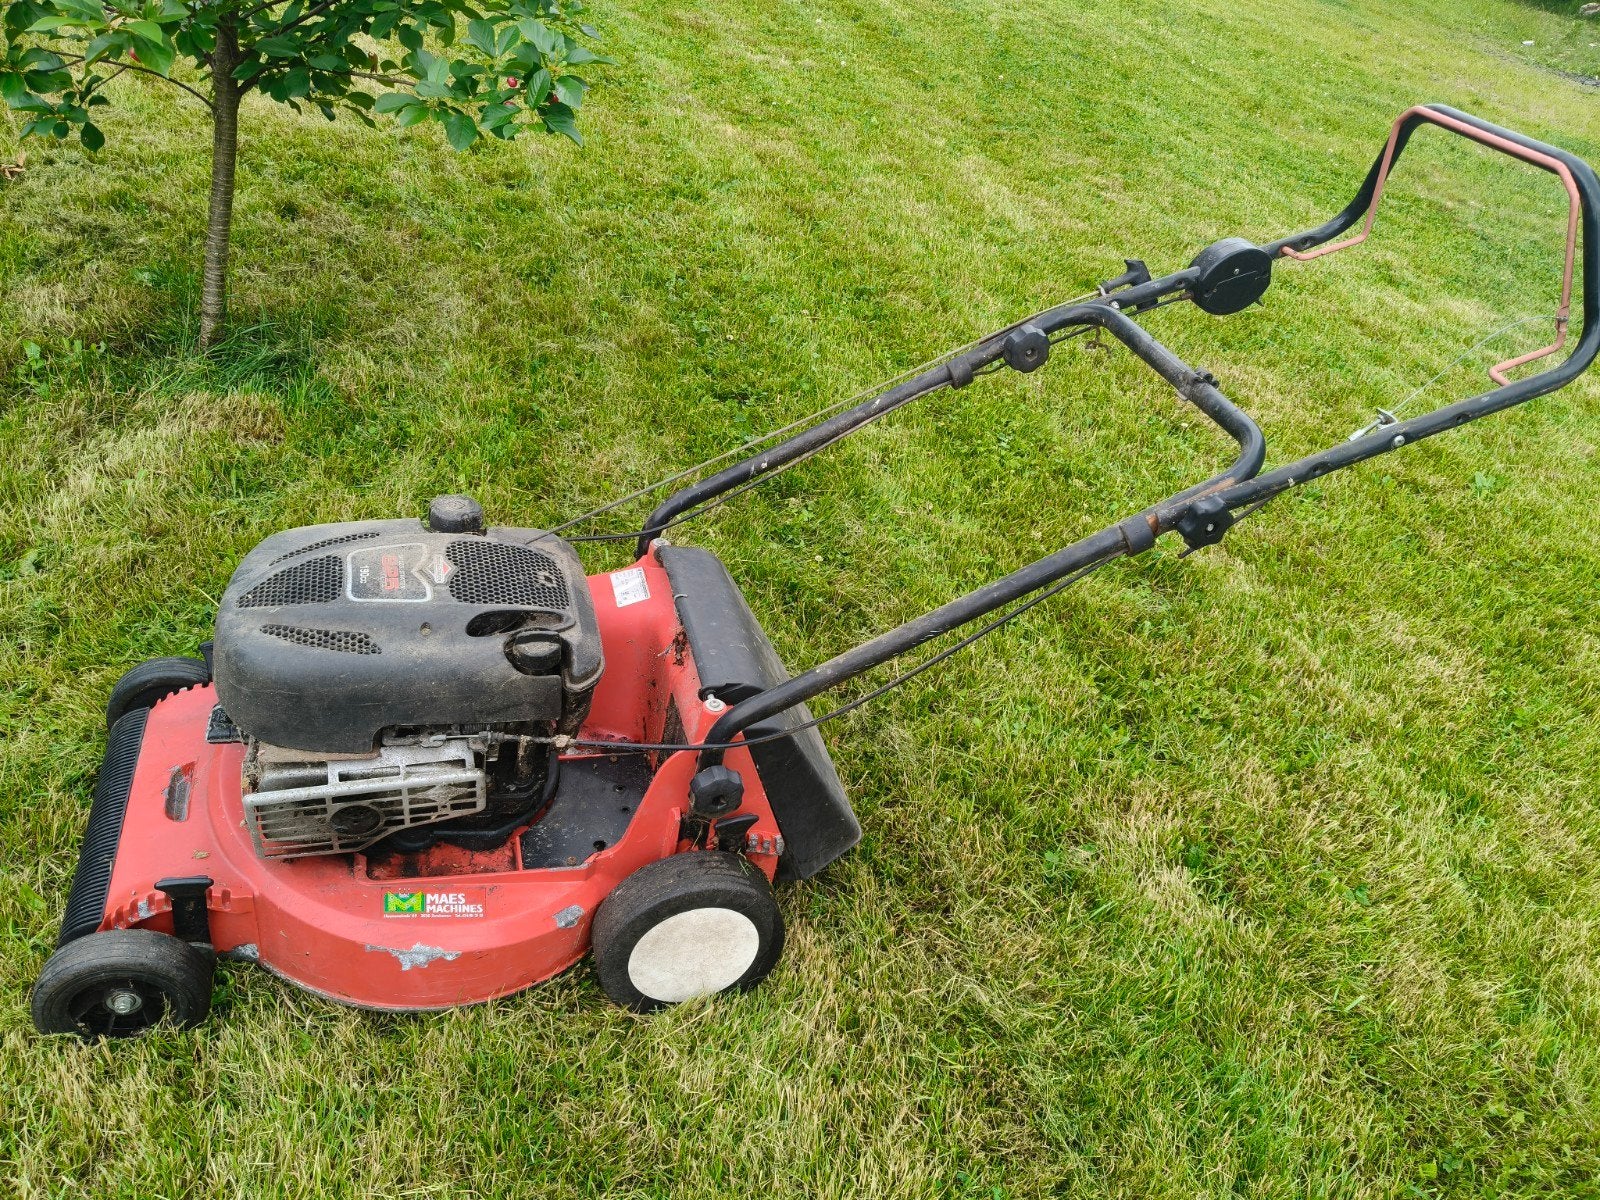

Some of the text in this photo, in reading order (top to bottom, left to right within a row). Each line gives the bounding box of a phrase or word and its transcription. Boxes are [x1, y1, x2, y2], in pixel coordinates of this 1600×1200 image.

[359, 565, 370, 584] 190cc
[426, 893, 466, 904] MAES
[426, 904, 483, 913] MACHINES
